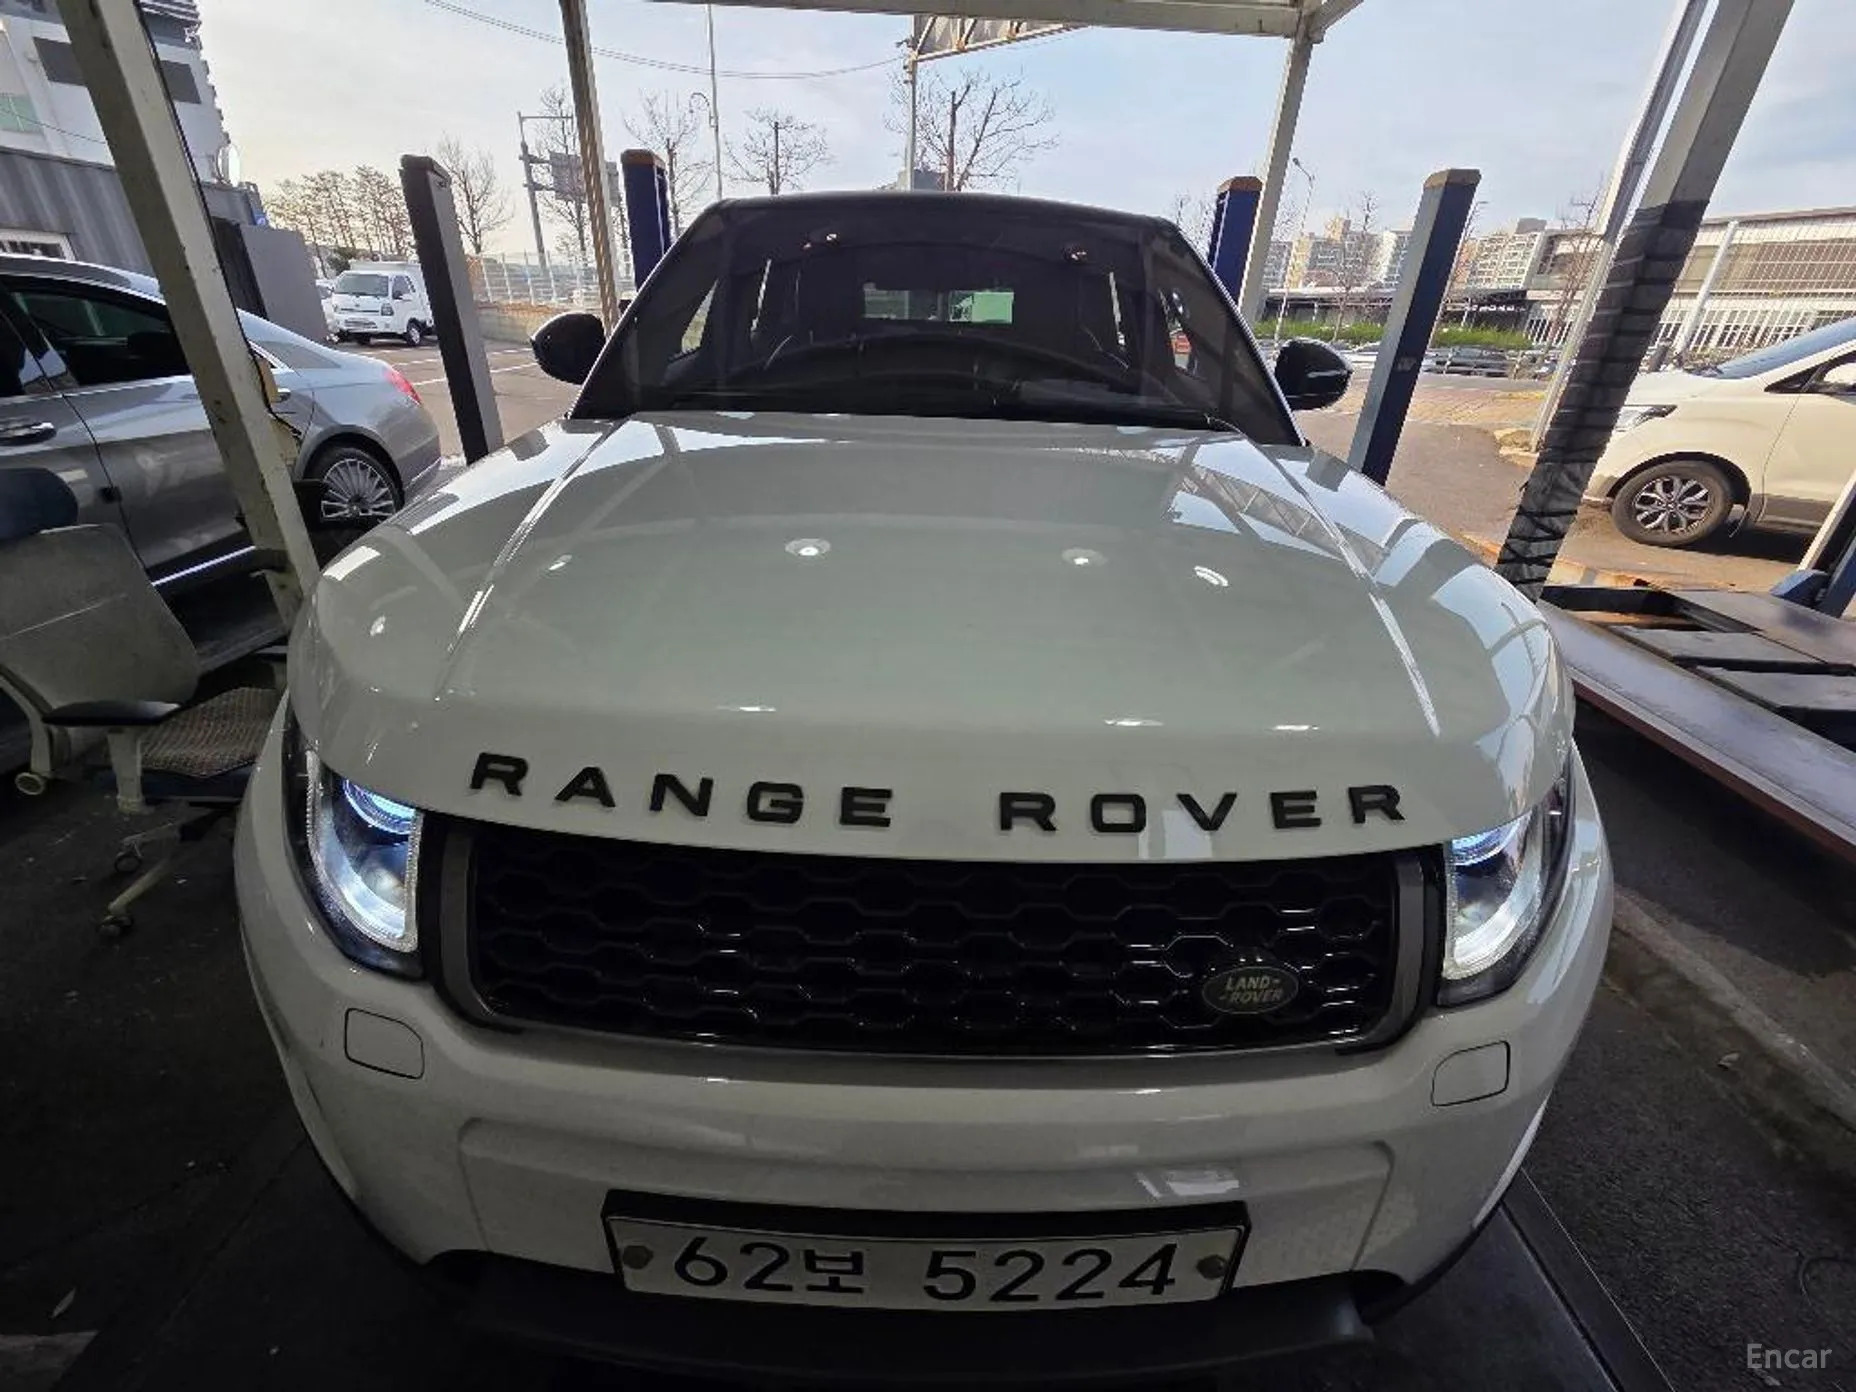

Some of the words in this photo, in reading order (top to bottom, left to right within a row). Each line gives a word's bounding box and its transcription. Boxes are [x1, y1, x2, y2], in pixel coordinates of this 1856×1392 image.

[470, 752, 893, 827] RANGE
[1000, 784, 1406, 833] ROVER
[1226, 975, 1270, 991] LAND
[673, 1236, 865, 1295] 62보
[923, 1243, 1178, 1302] 5224
